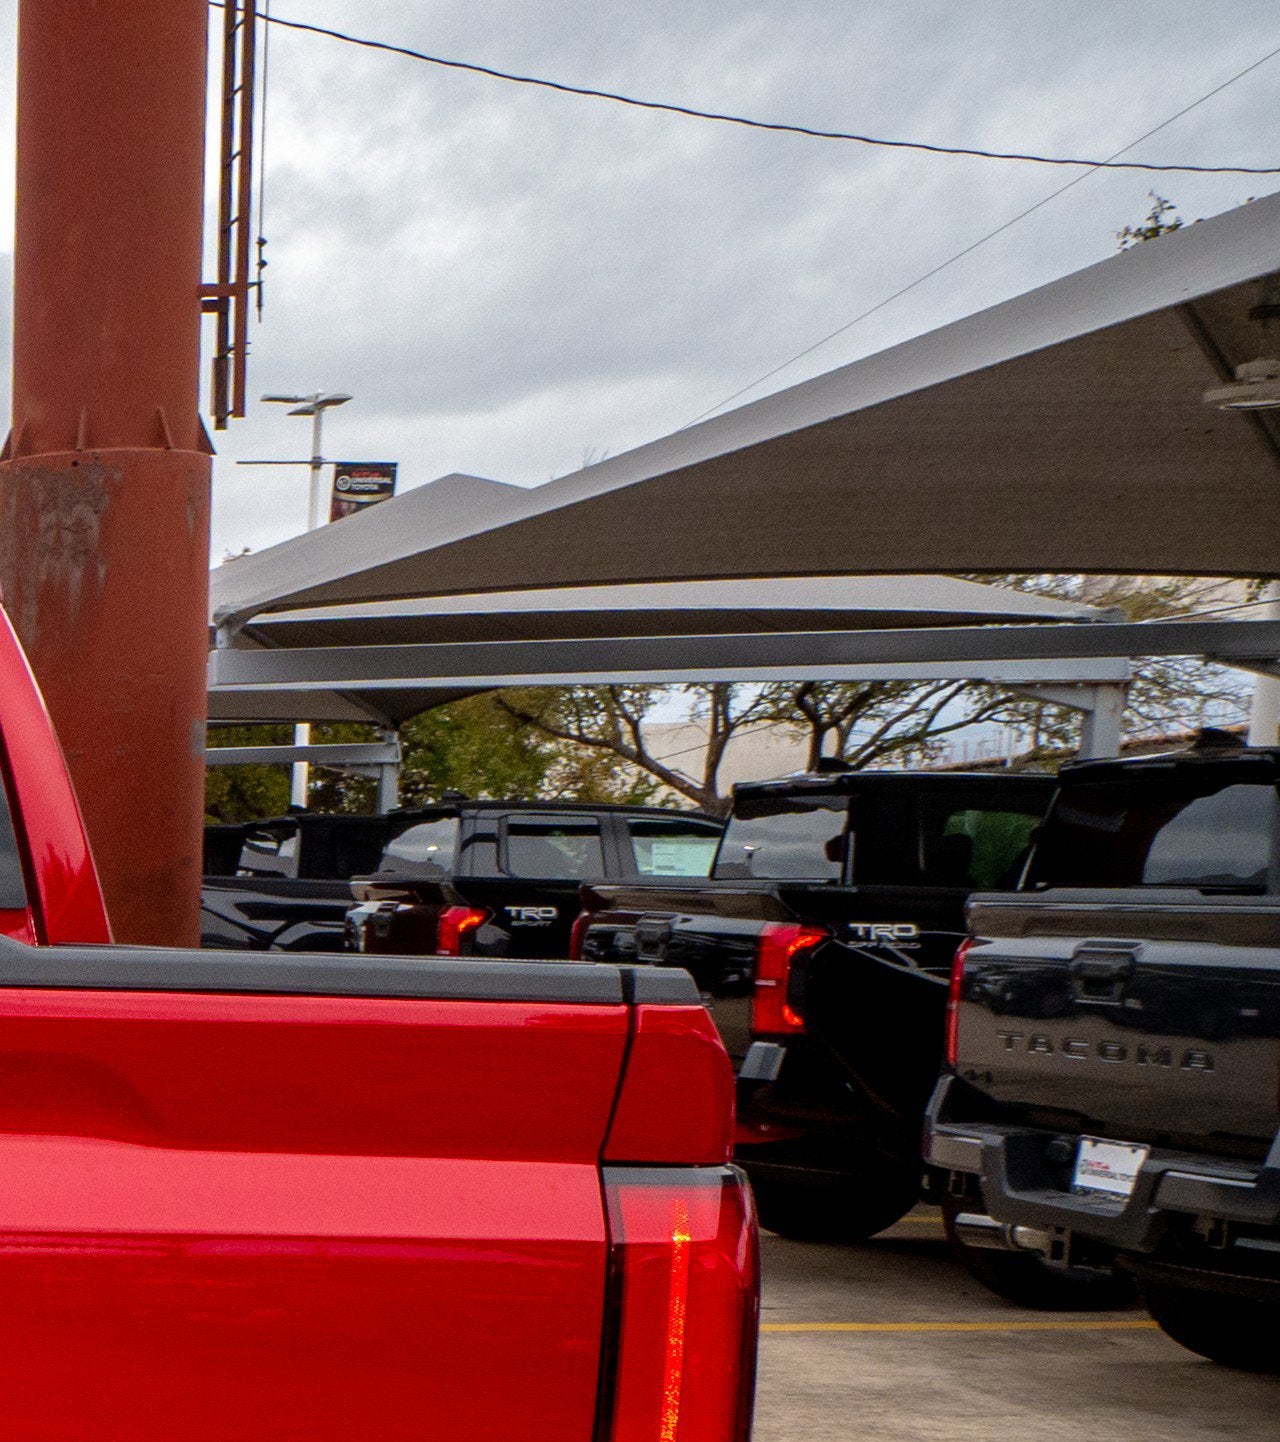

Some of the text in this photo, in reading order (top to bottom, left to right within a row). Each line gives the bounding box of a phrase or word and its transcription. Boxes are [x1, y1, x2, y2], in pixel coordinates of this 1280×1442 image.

[504, 906, 558, 920] TRD
[848, 923, 918, 940] TRD
[995, 1030, 1216, 1073] TACOMA
